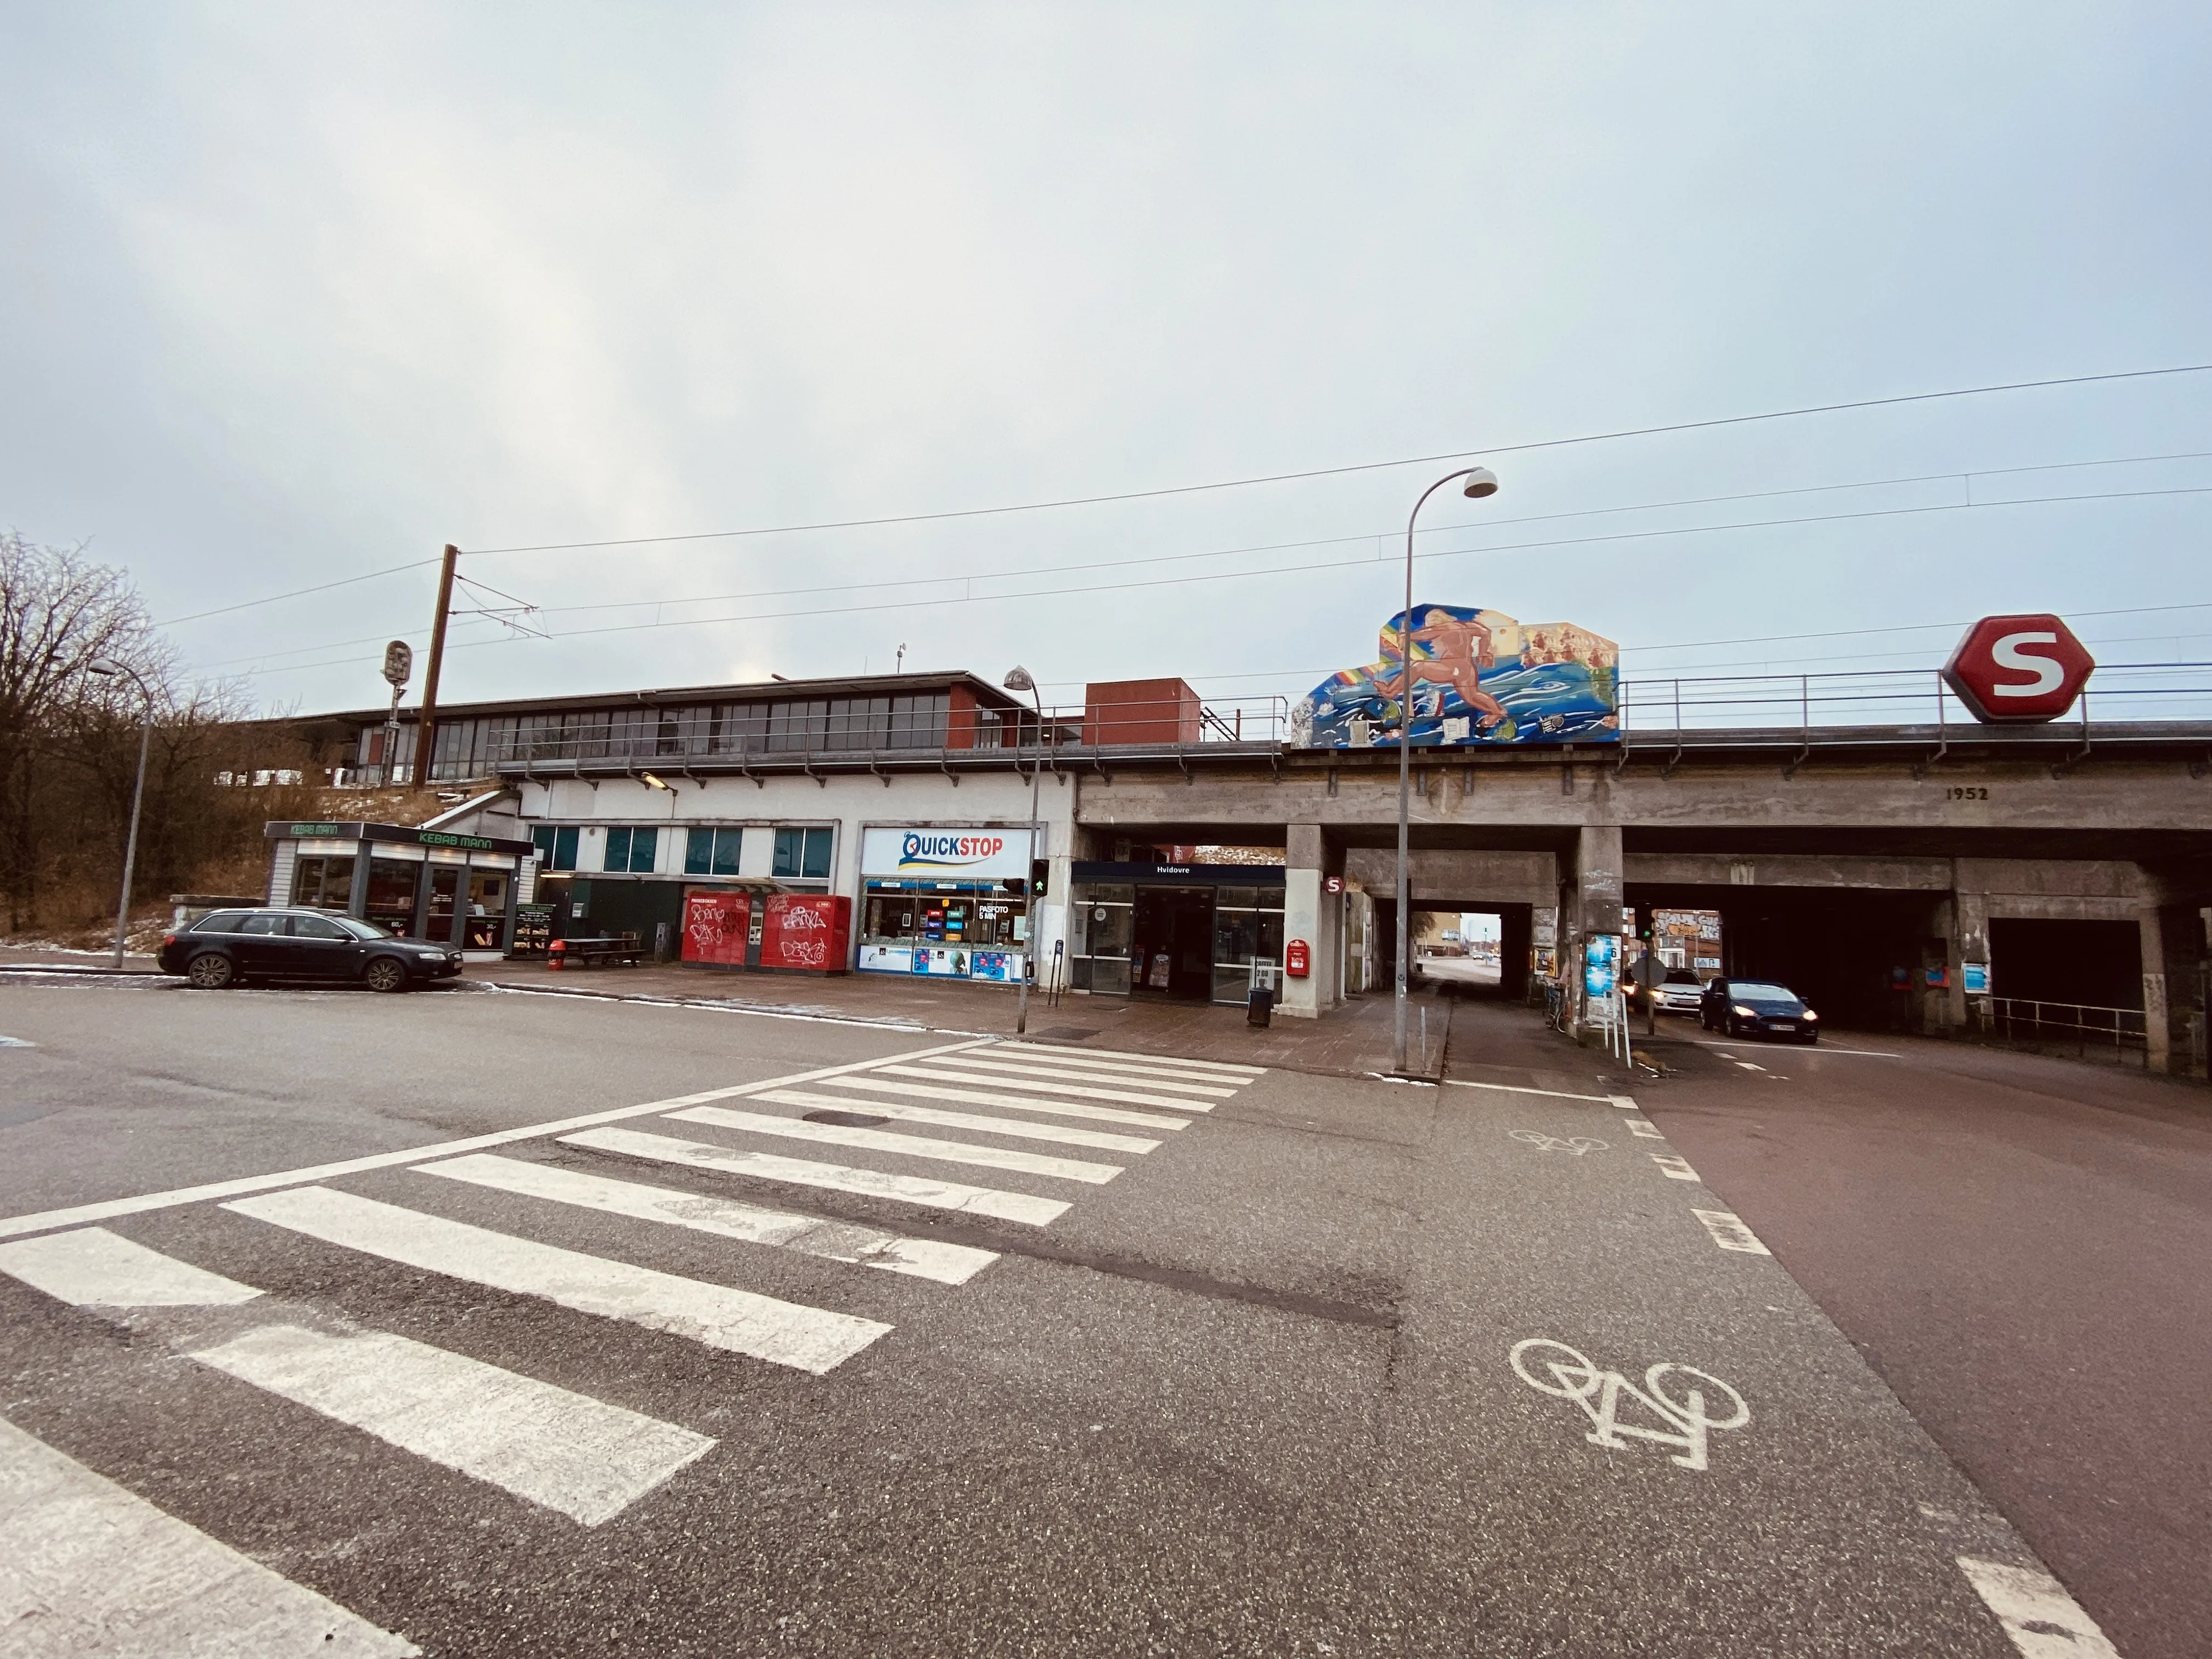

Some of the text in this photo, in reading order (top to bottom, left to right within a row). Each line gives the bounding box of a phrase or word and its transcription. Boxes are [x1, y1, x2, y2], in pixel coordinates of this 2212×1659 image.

[1992, 632, 2064, 696] S
[1946, 788, 1988, 800] 1952
[291, 825, 337, 834] KEBAB MANN
[419, 833, 492, 849] KEBAB MANN
[903, 831, 1003, 859] QUICKSTOP
[1328, 879, 1340, 892] S
[979, 905, 1009, 913] PASFOTO
